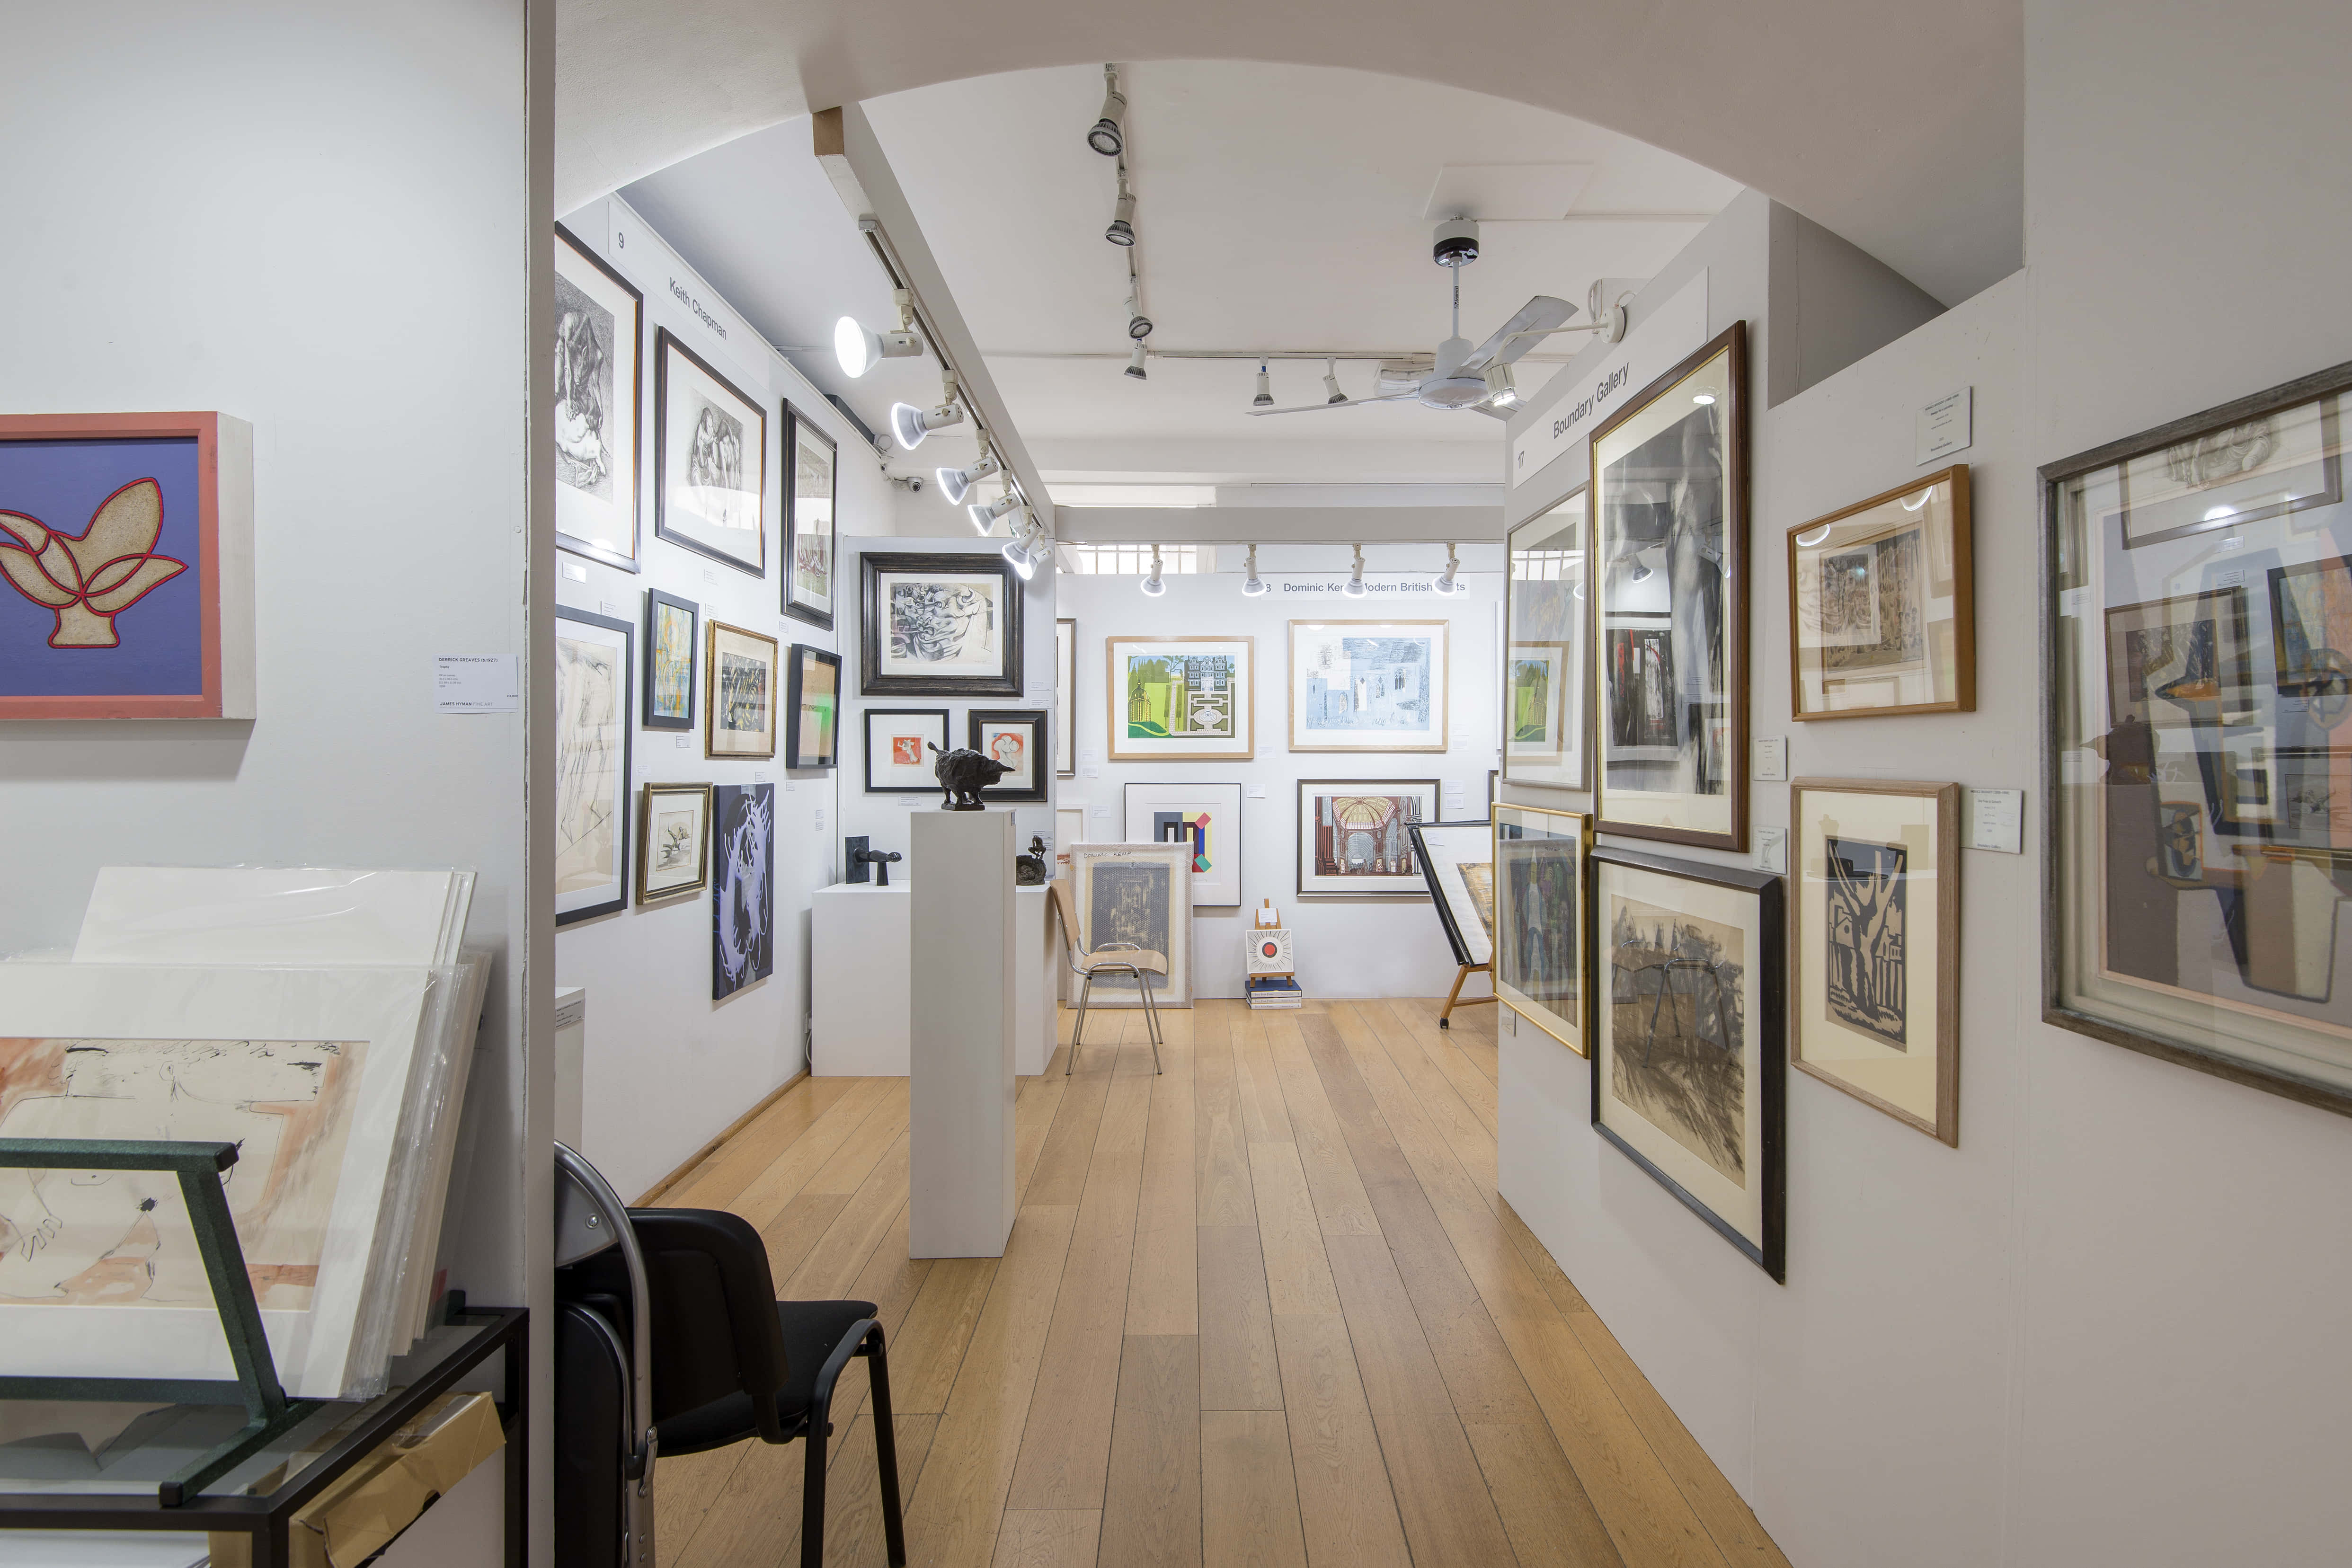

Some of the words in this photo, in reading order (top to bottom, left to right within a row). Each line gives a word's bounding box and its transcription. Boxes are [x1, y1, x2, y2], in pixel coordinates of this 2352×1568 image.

[618, 232, 624, 249] 9
[670, 276, 690, 308] Keith
[692, 299, 727, 340] Chapman
[1553, 394, 1594, 440] Boundary
[1597, 362, 1629, 403] Gallery
[1518, 450, 1525, 469] 17
[1284, 583, 1324, 592] Dominic
[1364, 583, 1397, 591] odern
[1401, 583, 1433, 591] British
